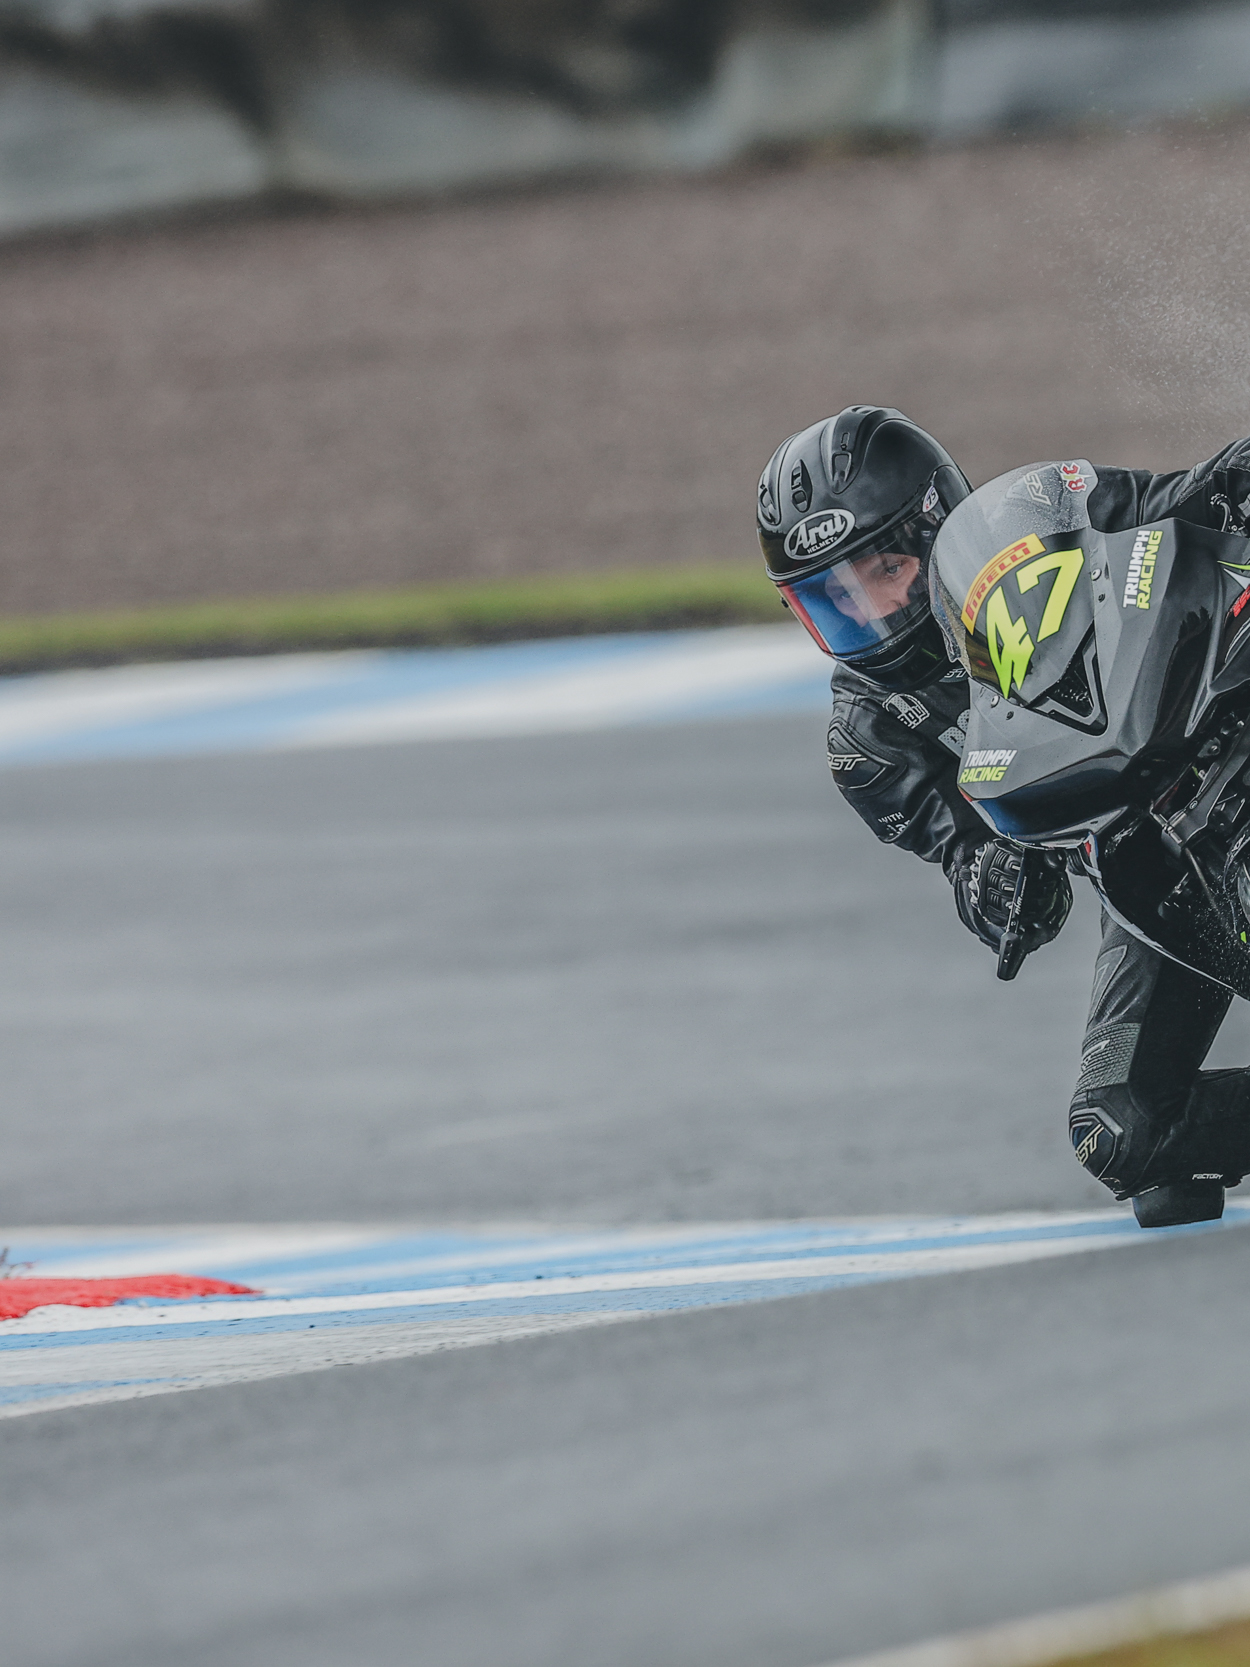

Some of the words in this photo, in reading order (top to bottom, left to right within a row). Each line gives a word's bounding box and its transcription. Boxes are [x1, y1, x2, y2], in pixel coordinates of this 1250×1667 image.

[790, 511, 846, 556] Arai
[807, 537, 835, 554] HELMET
[965, 542, 1031, 622] PIRELLI
[1122, 530, 1151, 608] TRIUMPH
[1136, 530, 1164, 610] RACING
[986, 547, 1086, 700] 47
[943, 668, 969, 679] ST
[959, 766, 1008, 784] RACING
[964, 749, 1018, 767] TRIUMPH
